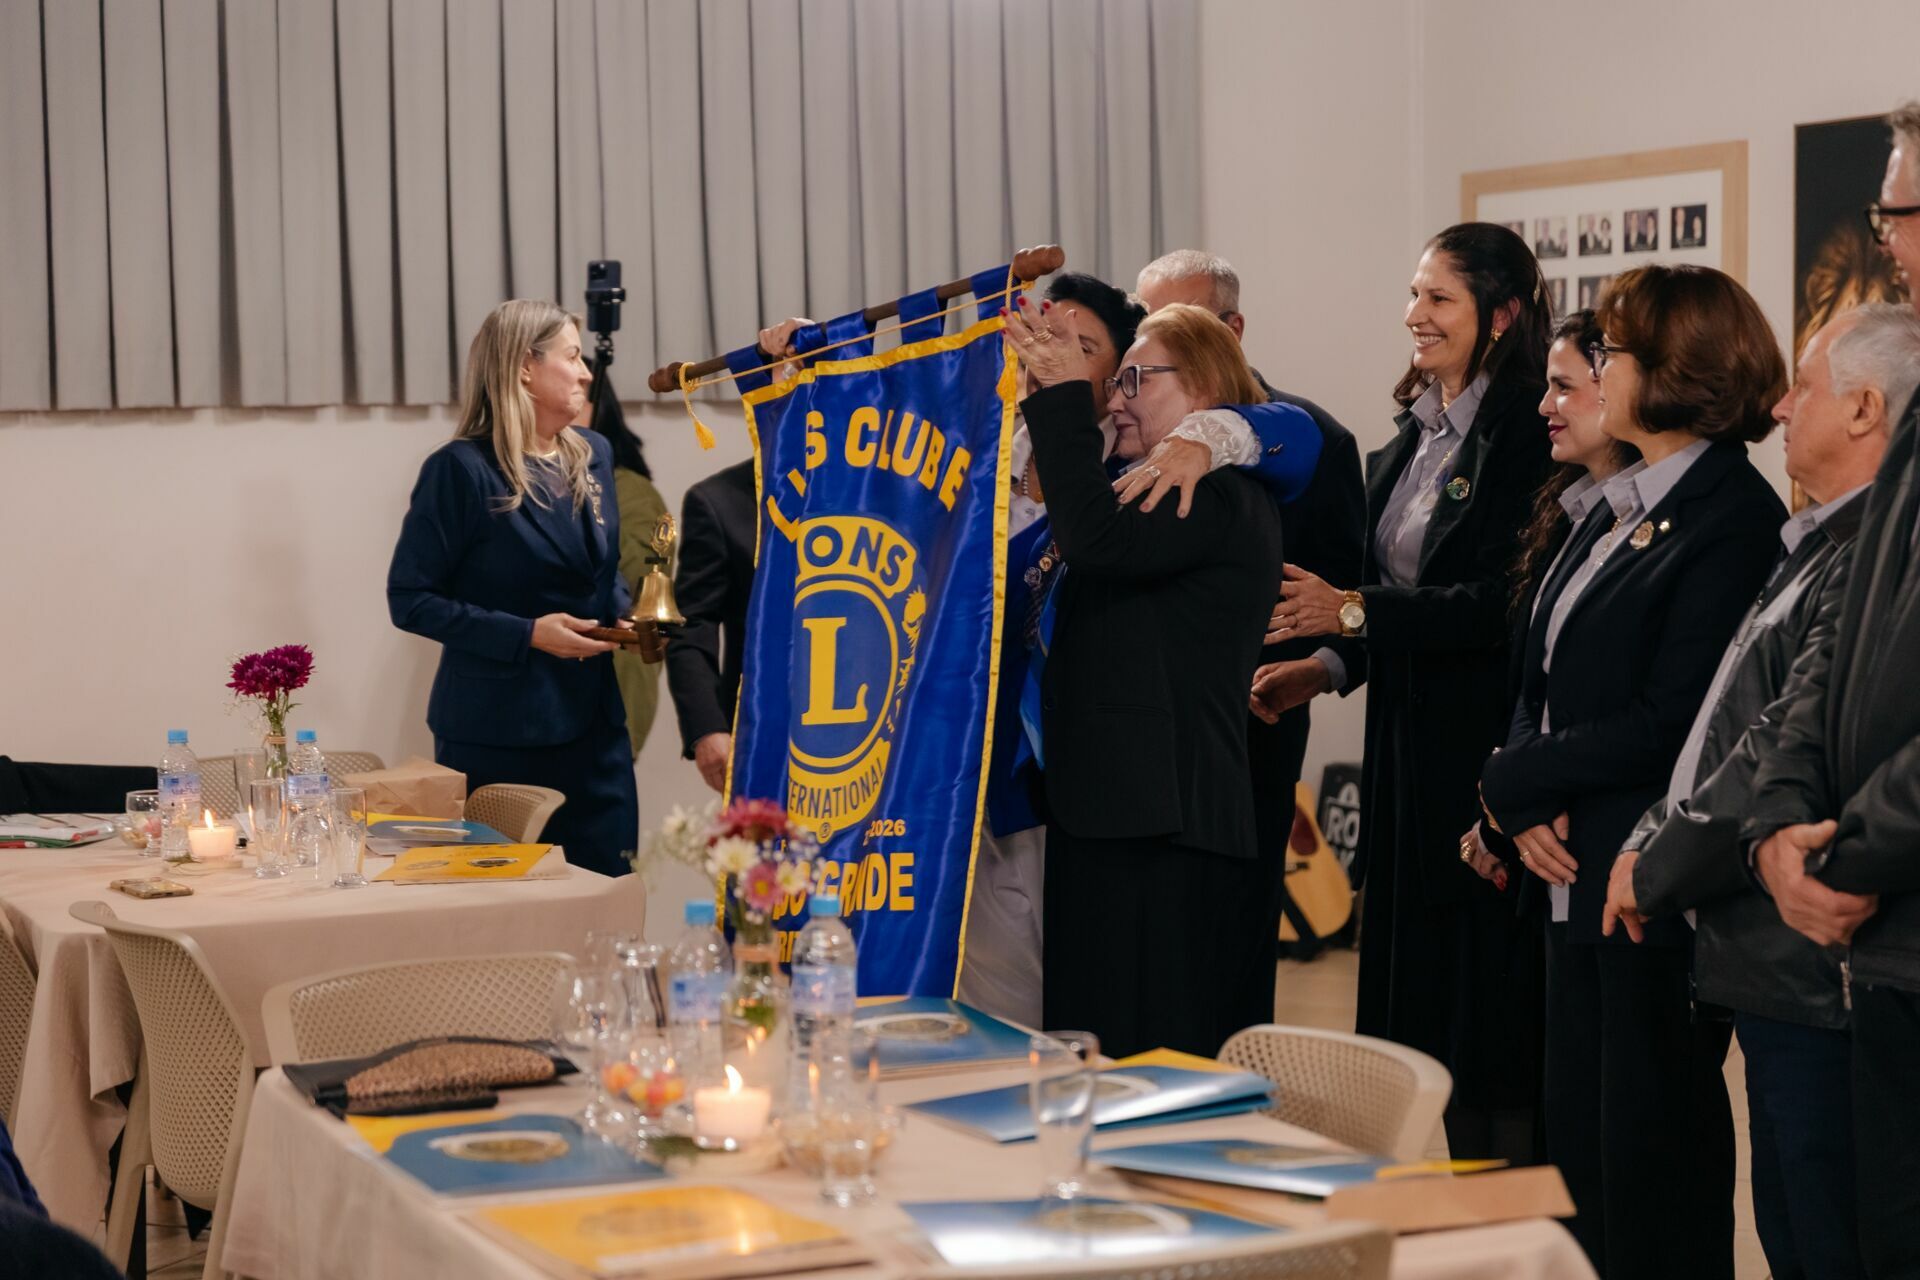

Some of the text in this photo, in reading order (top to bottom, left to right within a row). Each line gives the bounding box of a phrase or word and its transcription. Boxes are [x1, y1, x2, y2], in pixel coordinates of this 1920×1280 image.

[845, 406, 972, 512] CLUBE
[803, 525, 907, 587] ONS
[801, 617, 869, 726] L
[789, 757, 885, 819] ERNATIONAL
[816, 852, 915, 917] GRDE
